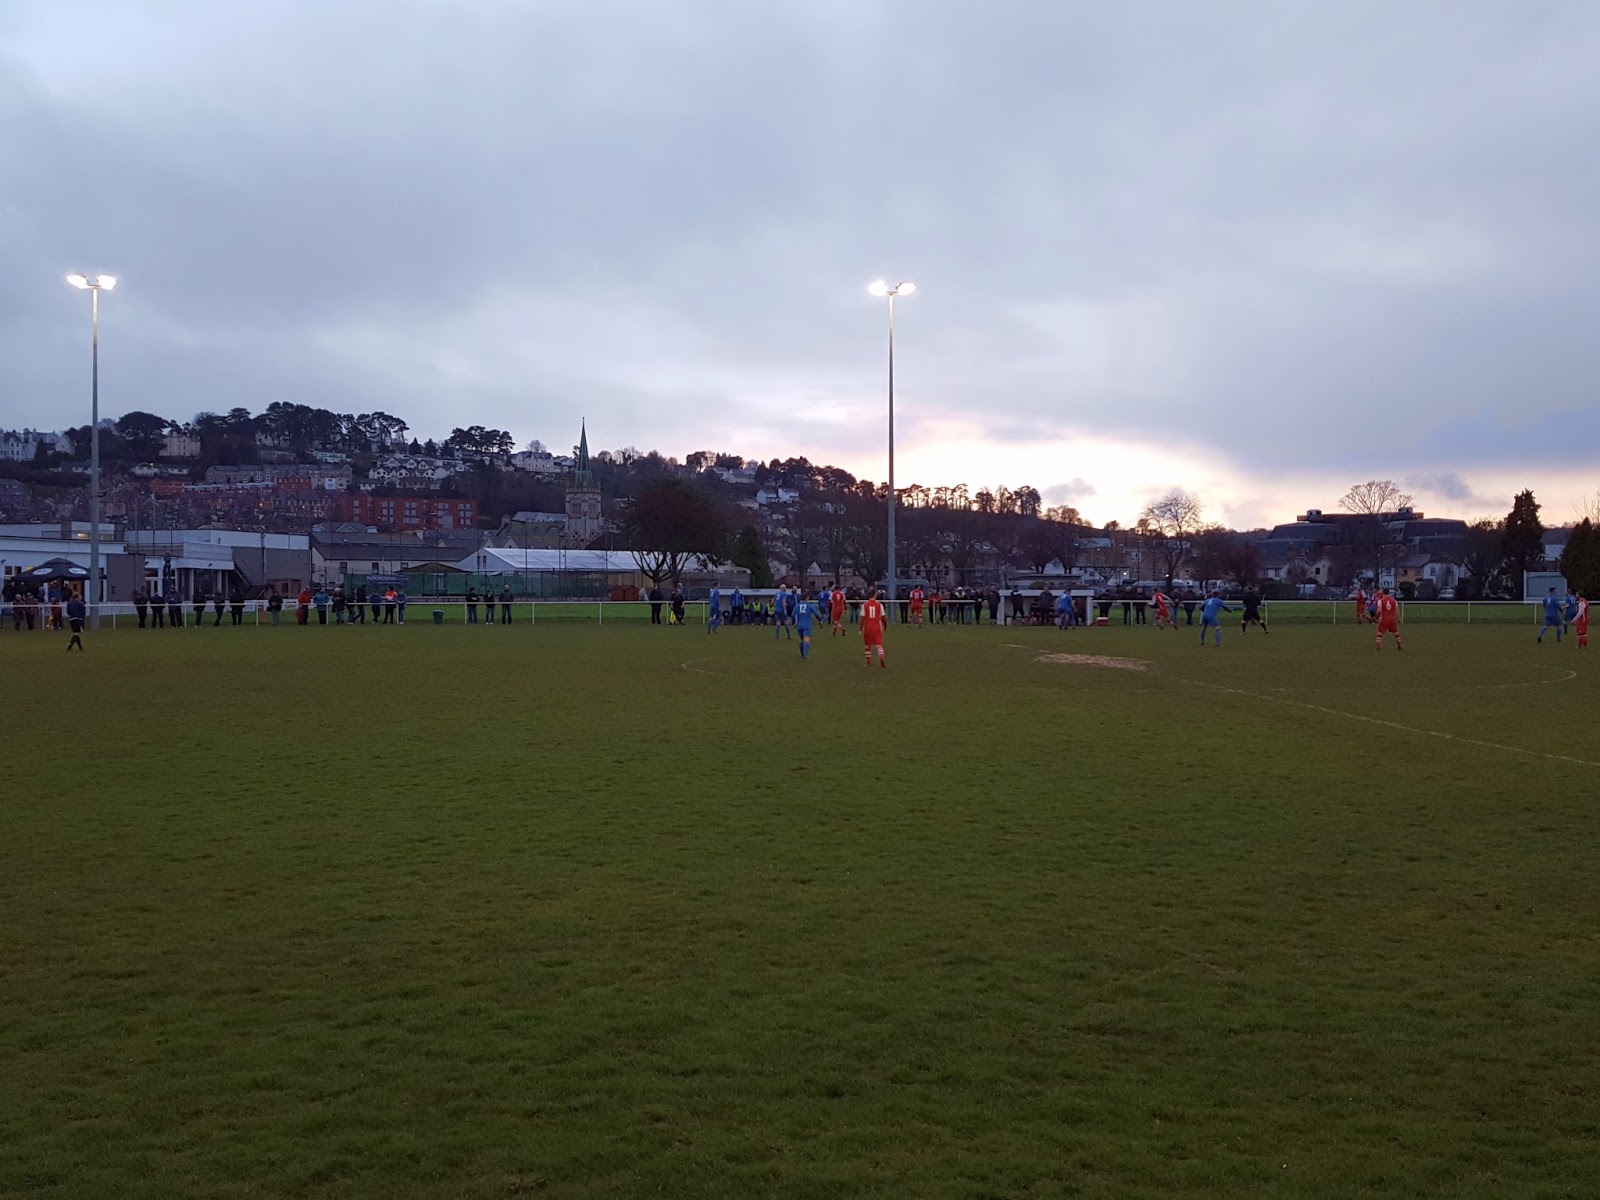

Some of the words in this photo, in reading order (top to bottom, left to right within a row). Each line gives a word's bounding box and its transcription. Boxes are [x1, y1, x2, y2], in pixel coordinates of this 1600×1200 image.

[1386, 600, 1392, 610] 6
[1546, 597, 1551, 605] 9
[800, 604, 807, 613] 12
[869, 606, 876, 618] 11
